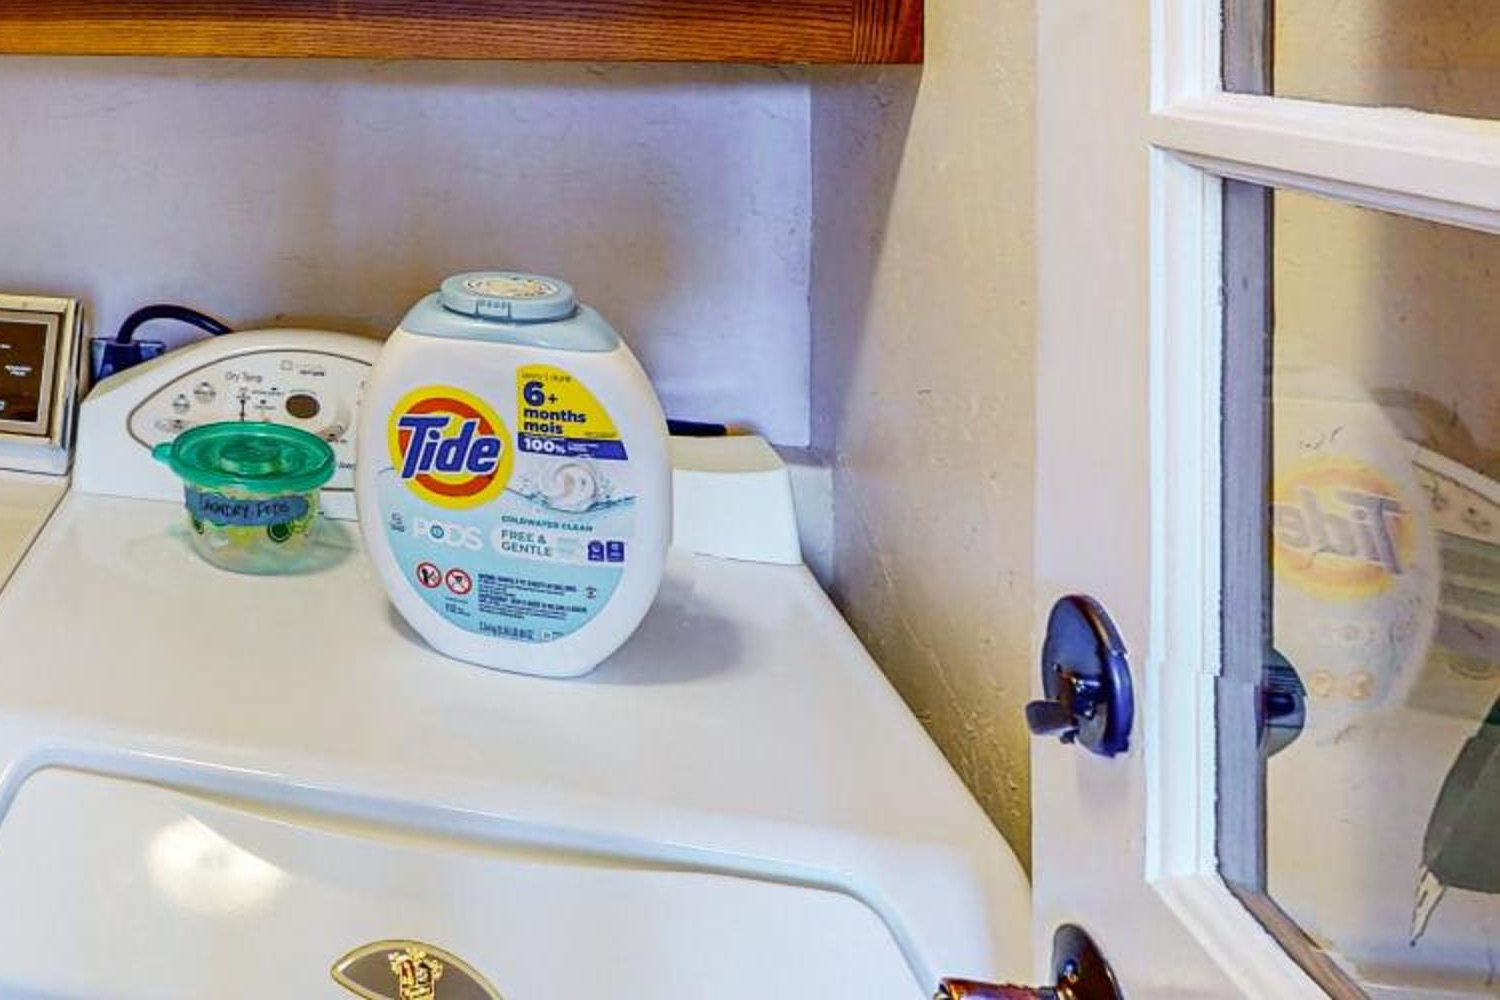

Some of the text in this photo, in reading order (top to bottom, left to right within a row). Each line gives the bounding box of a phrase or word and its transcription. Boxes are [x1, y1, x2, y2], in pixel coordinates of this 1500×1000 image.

[523, 408, 587, 424] months
[523, 421, 563, 435] mois
[398, 416, 502, 479] Tide
[524, 437, 567, 454] 100%
[501, 529, 547, 545] FREE &
[501, 541, 552, 557] GENTLE
